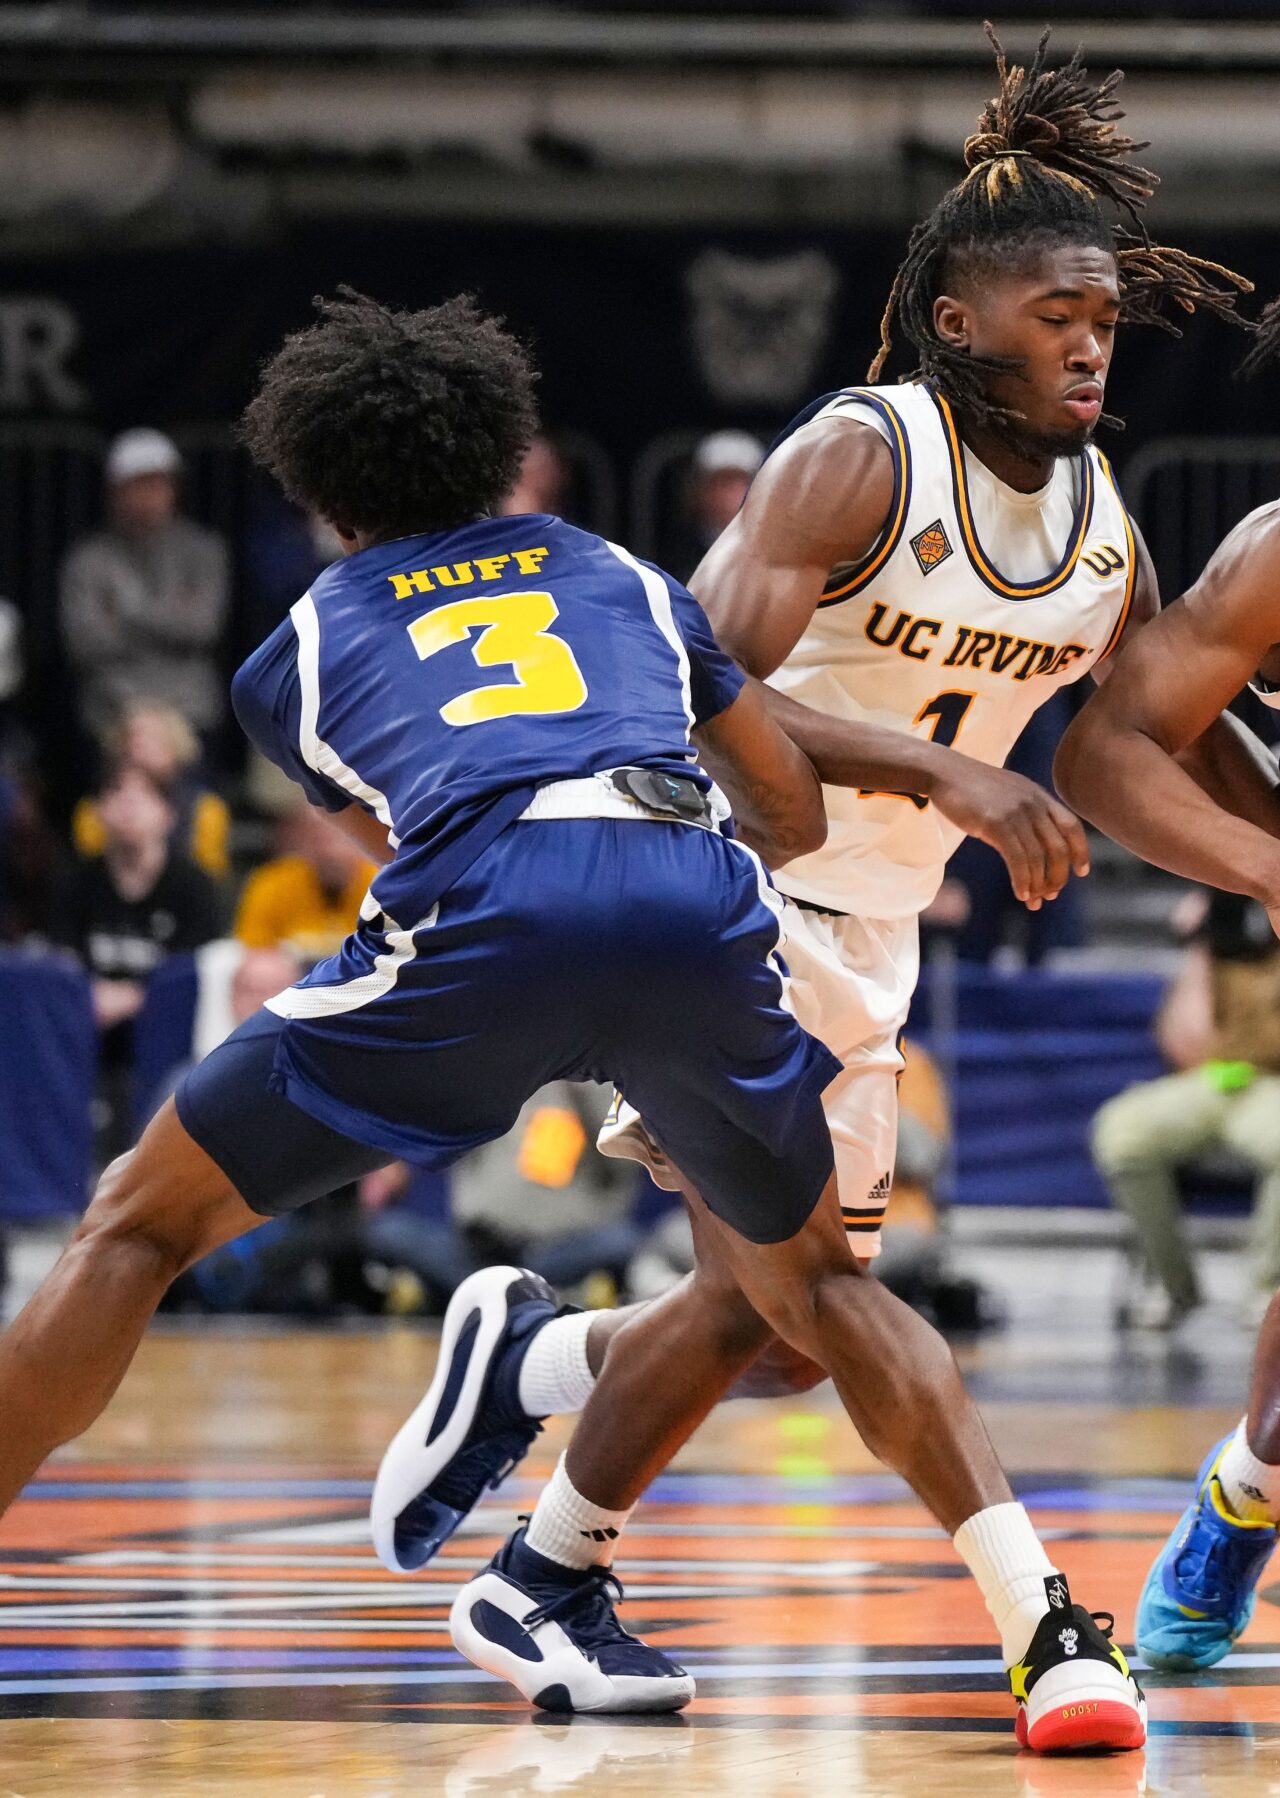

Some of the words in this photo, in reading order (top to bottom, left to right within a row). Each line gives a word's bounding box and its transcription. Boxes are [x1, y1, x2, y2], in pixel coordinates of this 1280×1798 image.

[387, 547, 549, 600] HUFF
[407, 591, 589, 727] 3
[864, 600, 945, 663] UC
